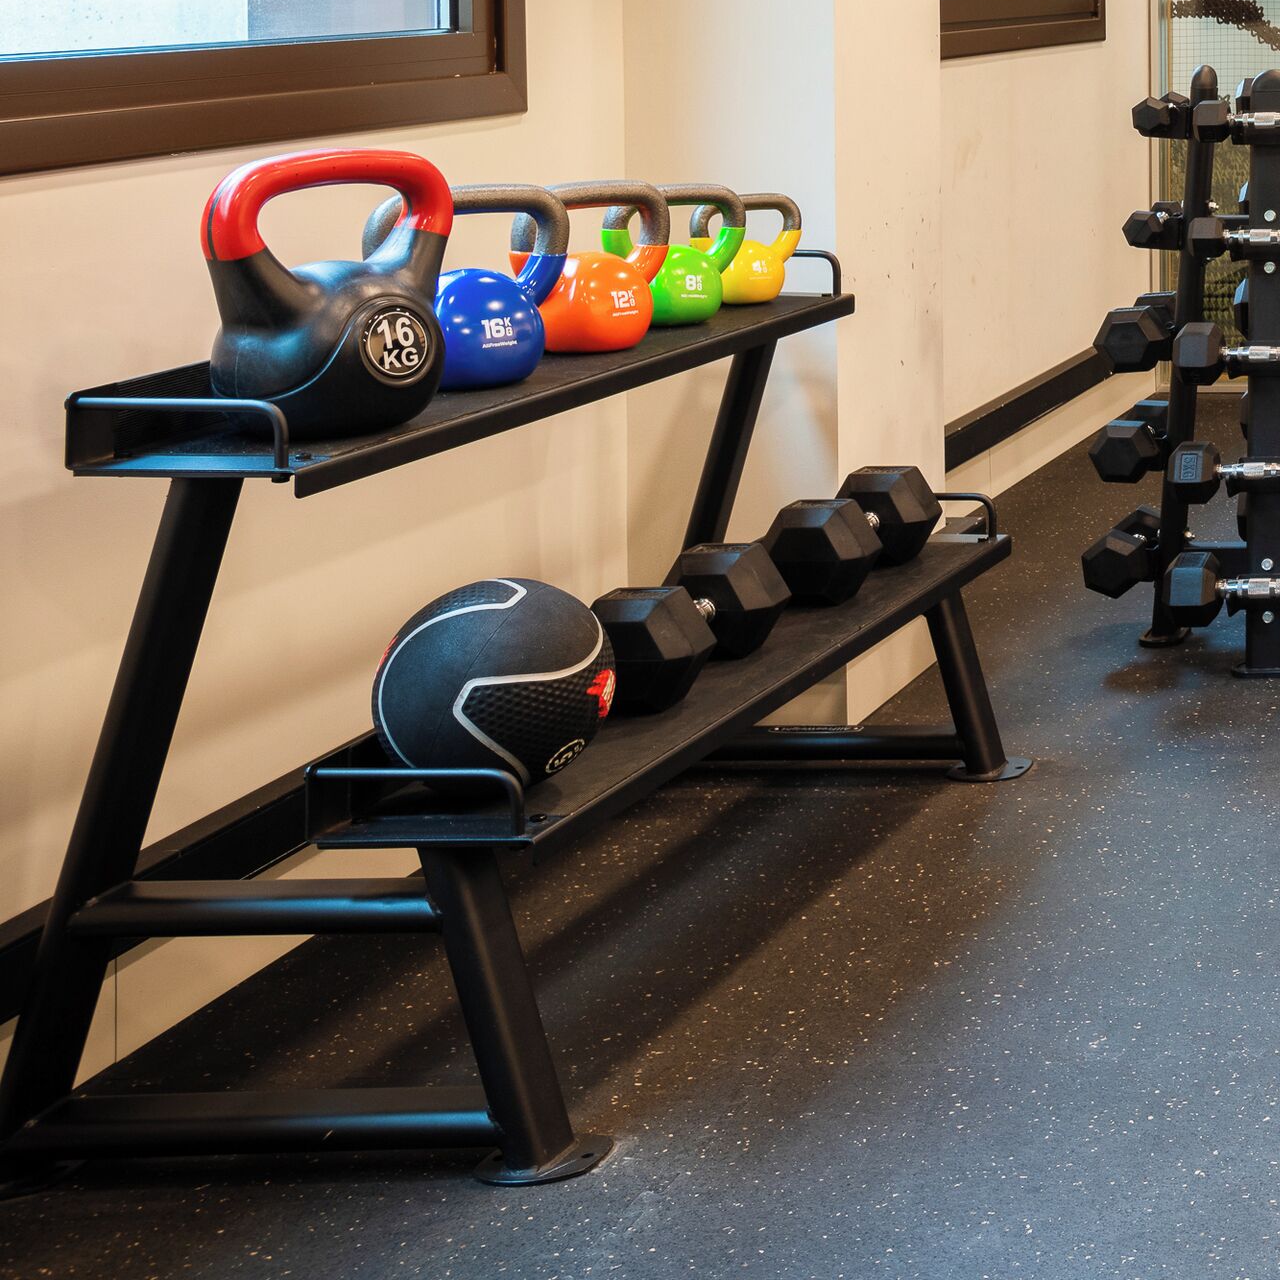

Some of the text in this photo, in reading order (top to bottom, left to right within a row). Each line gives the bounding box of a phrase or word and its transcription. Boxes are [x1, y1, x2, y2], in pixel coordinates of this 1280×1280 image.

[752, 260, 762, 273] 4
[685, 275, 697, 291] 8
[610, 291, 630, 308] 12
[376, 316, 415, 349] 16
[481, 317, 505, 339] 16
[383, 347, 419, 370] KG
